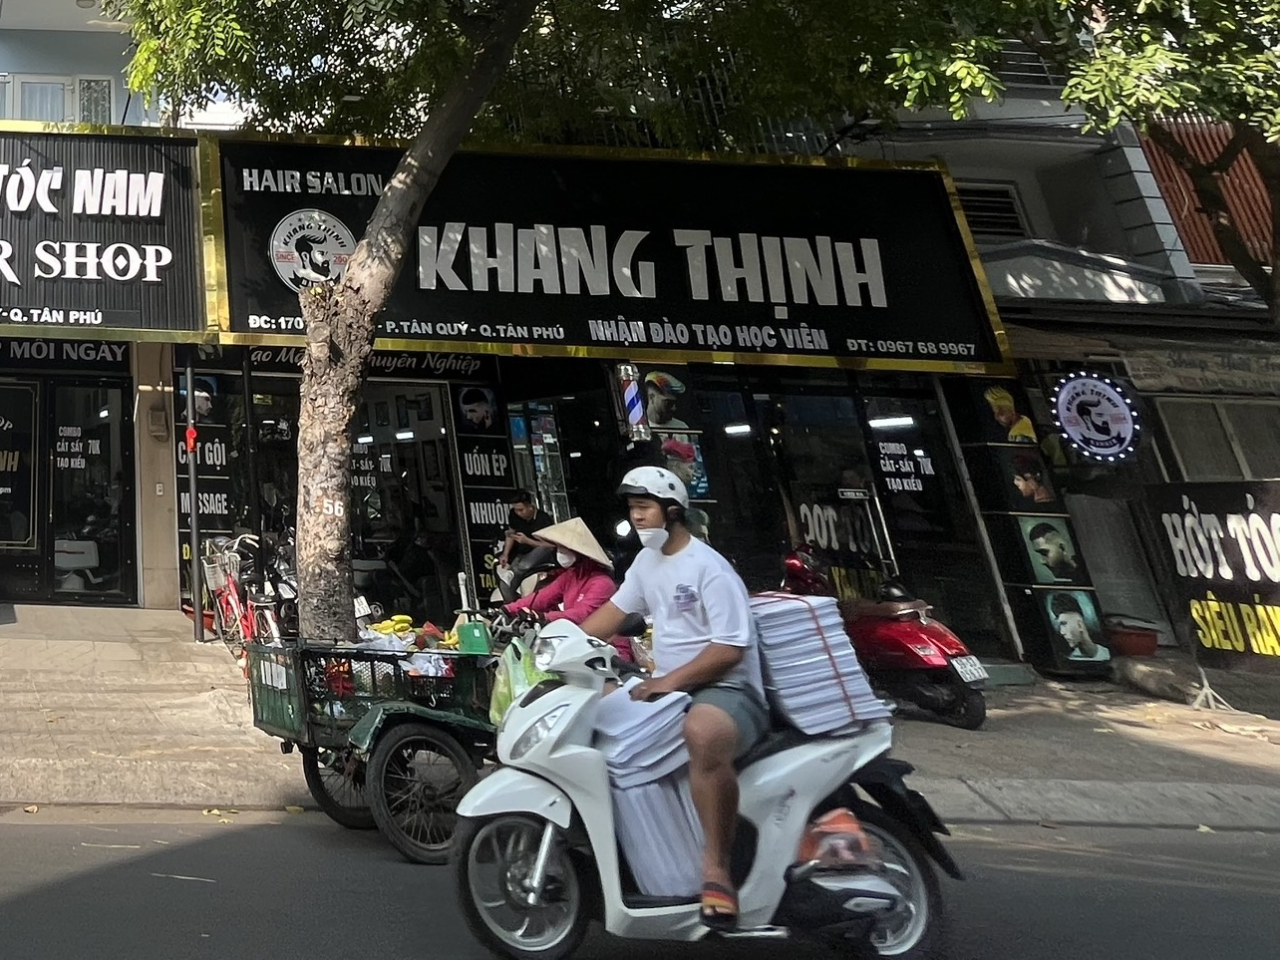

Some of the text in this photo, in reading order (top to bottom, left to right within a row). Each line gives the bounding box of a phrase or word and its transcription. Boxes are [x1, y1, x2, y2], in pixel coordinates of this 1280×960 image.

[73, 167, 166, 219] NAM
[242, 168, 384, 197] HAIR SALON
[283, 223, 313, 247] KHANG
[33, 240, 173, 282] SHOP
[275, 253, 295, 261] SINCE
[333, 254, 348, 263] 200
[418, 222, 888, 319] KHANG THỊNH
[69, 308, 102, 324] PHÚ
[278, 315, 304, 330] 170
[436, 320, 470, 338] QUÝ
[531, 324, 565, 340] PHÚ
[588, 315, 829, 353] NHẬN ĐÀO TẠO HỌC VIÊN
[62, 340, 126, 362] NGÀY
[846, 338, 976, 356] ĐT: 0967 68 9967
[366, 353, 481, 376] huyên Nghiệp
[177, 438, 227, 471] CT GỘI
[878, 442, 908, 455] COMBO
[464, 446, 508, 477] UỐN ÉP
[0, 487, 12, 495] pm
[181, 492, 229, 515] MSSAGE
[322, 499, 344, 517] 56
[1161, 494, 1234, 581] HỚT
[1190, 590, 1246, 653] SIÊU
